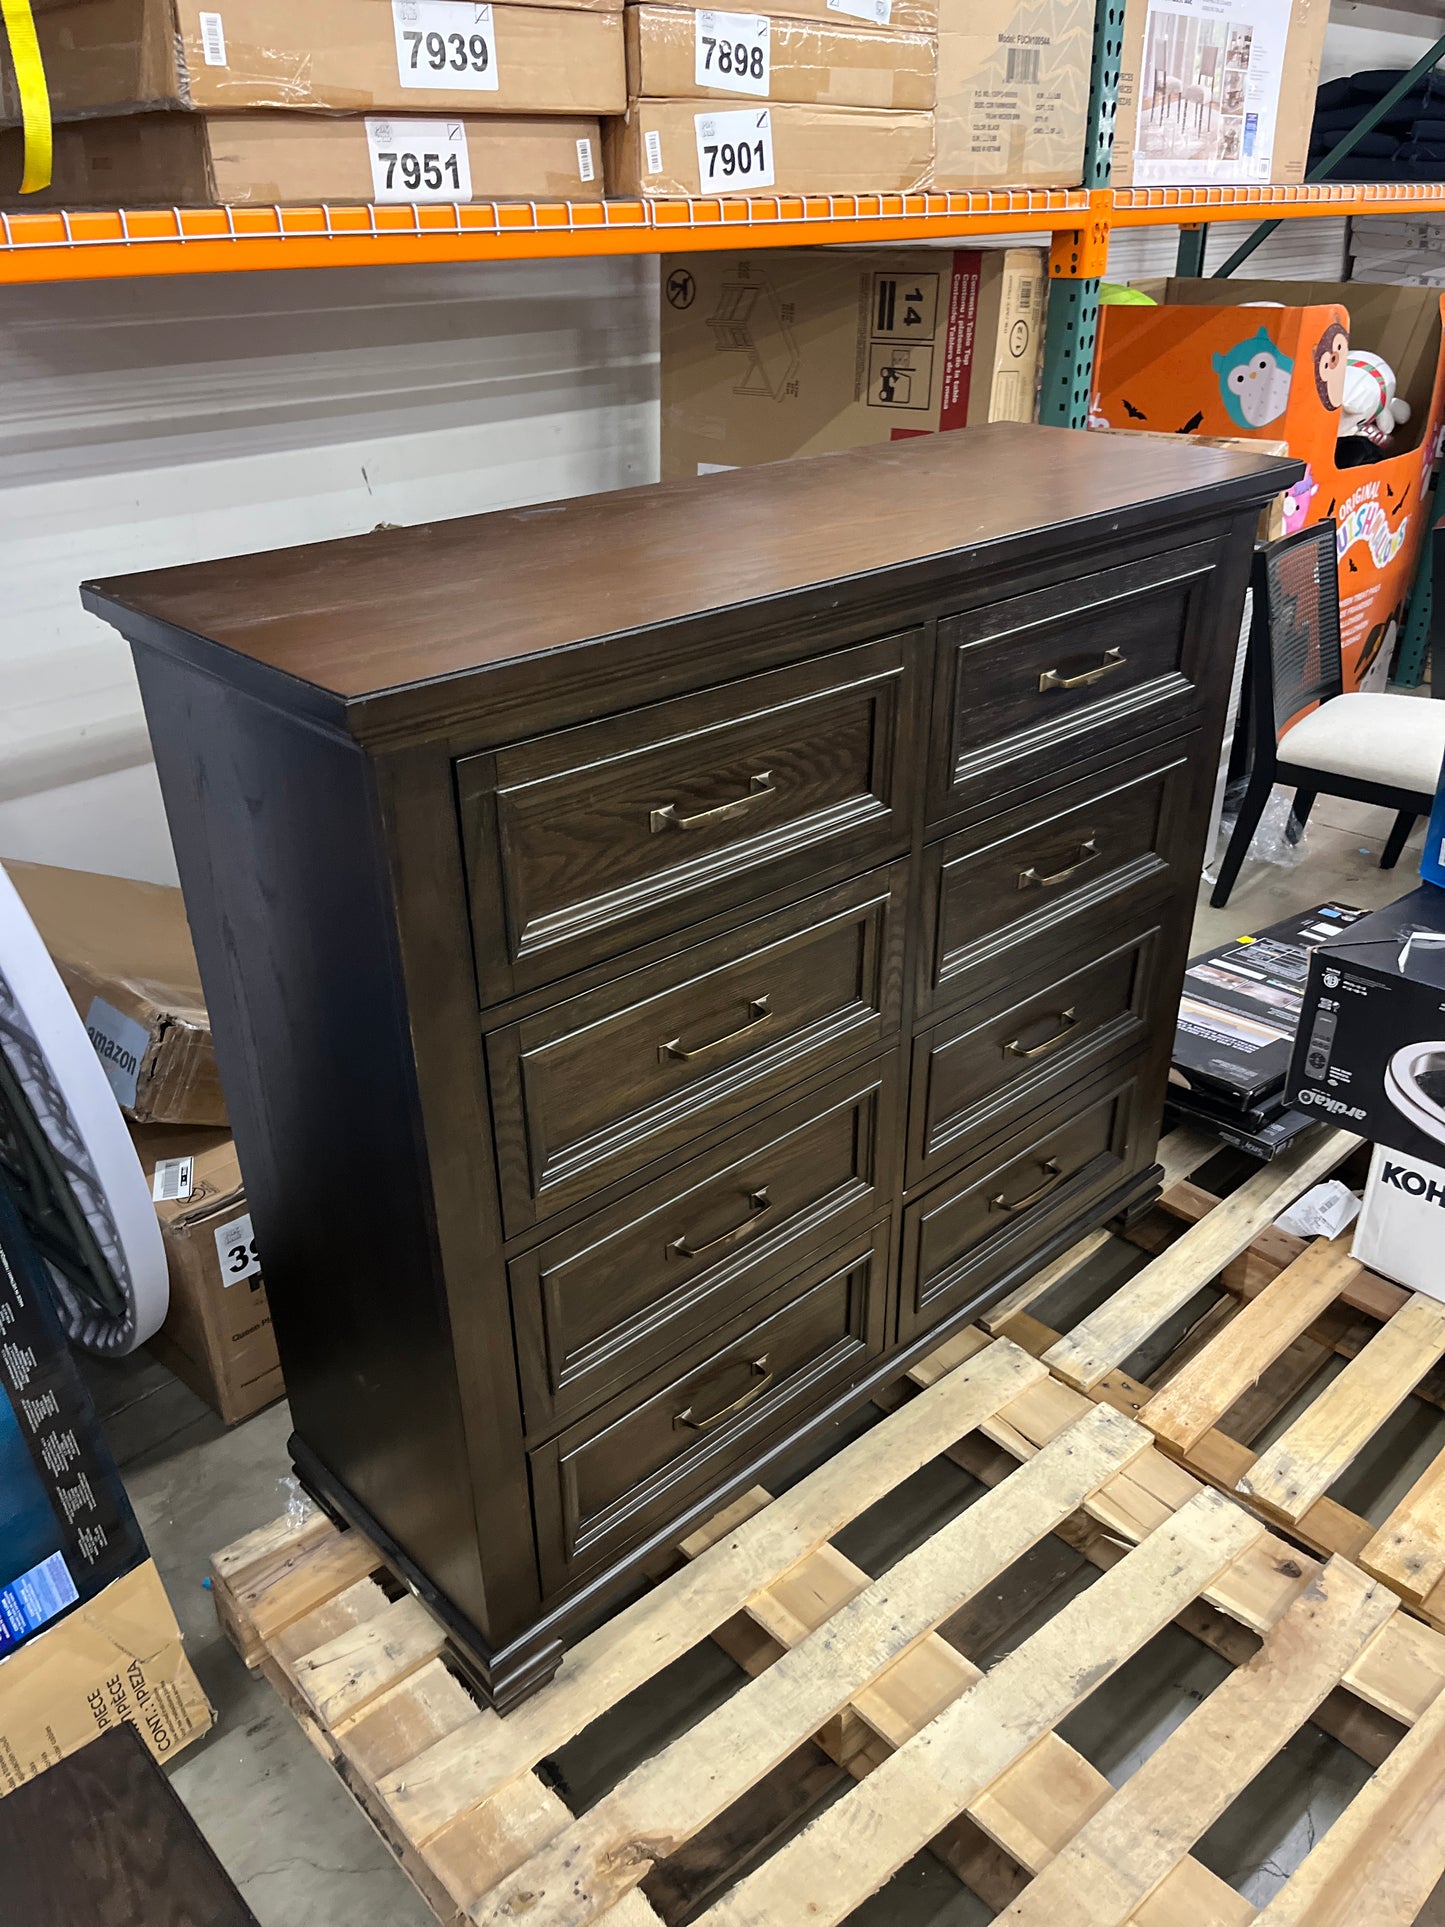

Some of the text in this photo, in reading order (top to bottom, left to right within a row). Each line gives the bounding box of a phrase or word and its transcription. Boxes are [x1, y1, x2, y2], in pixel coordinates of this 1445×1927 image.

[403, 31, 488, 72] 7939
[702, 36, 763, 79] 7898
[378, 153, 460, 190] 7951
[704, 140, 765, 178] 7901
[903, 288, 923, 327] 14
[963, 274, 978, 366] Contents: Table Top
[947, 325, 957, 361] Tablero
[955, 320, 965, 355] plateau
[945, 375, 952, 384] la
[951, 380, 960, 404] table
[953, 370, 961, 379] la
[943, 385, 951, 410] mesa
[1339, 480, 1381, 521] ORIGINAL
[87, 1026, 137, 1076] amazon
[1314, 1094, 1367, 1120] artika
[1381, 1161, 1445, 1209] KOH
[232, 1323, 260, 1342] Queen
[106, 1674, 130, 1715] PIÈCE
[127, 1660, 149, 1701] PIEZA
[87, 1688, 112, 1729] PIECE
